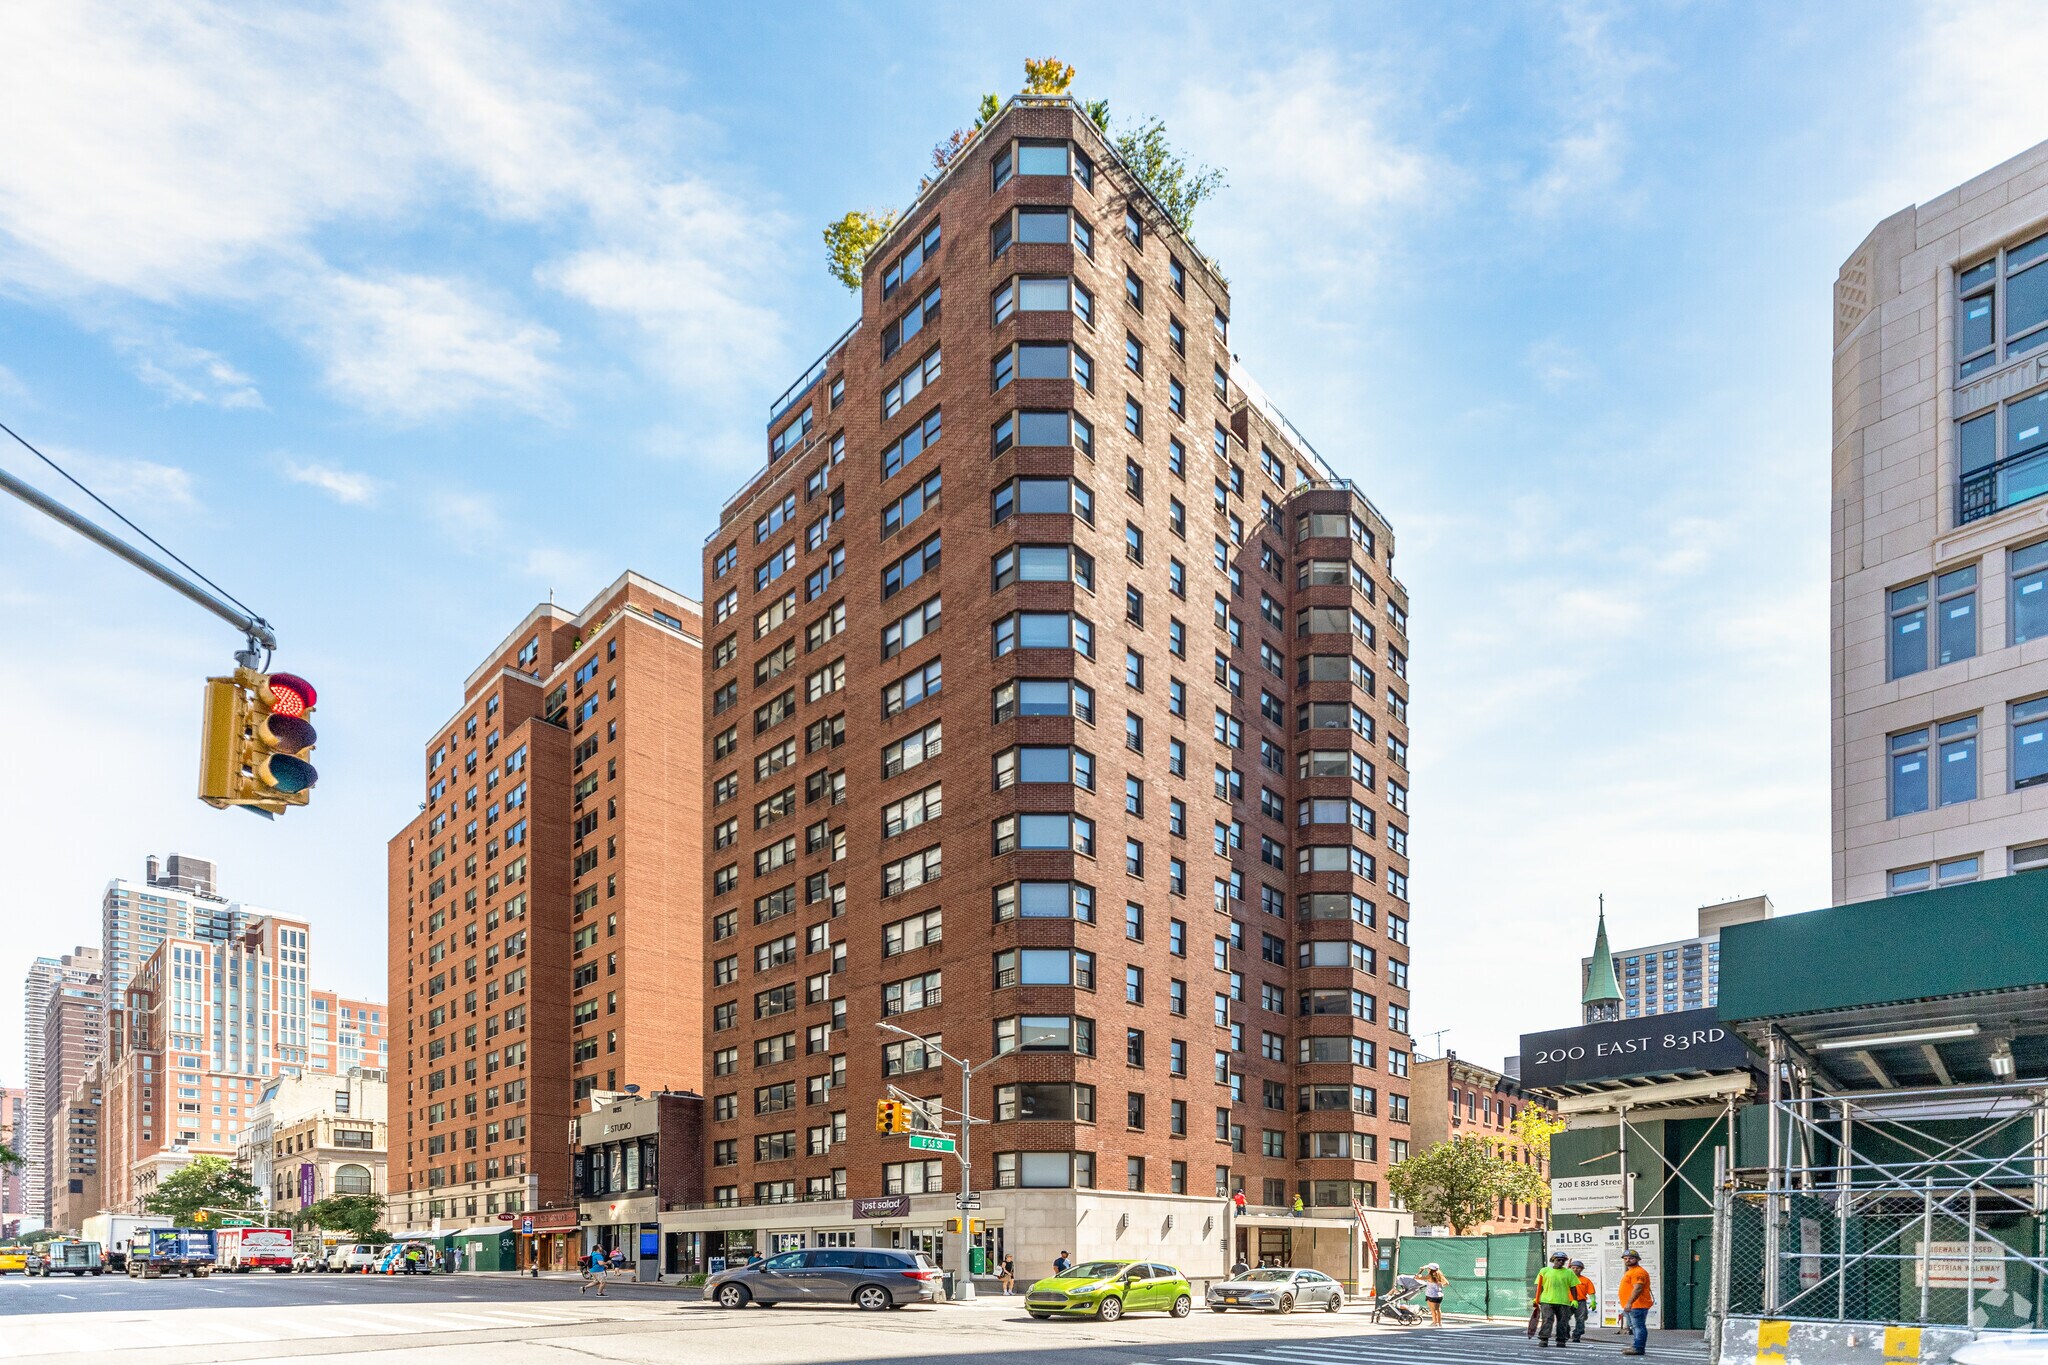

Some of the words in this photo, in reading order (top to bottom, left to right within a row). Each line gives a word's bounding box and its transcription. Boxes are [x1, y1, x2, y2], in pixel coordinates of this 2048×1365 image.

[1535, 1046, 1585, 1065] 200
[1597, 1037, 1652, 1057] EAST
[1663, 1028, 1725, 1050] 83RD
[610, 1122, 632, 1133] STUDIO
[922, 1139, 926, 1147] E
[936, 1140, 943, 1149] St
[1558, 1181, 1572, 1189] 200
[1580, 1179, 1599, 1188] 83rd
[1600, 1179, 1623, 1187] Stree
[877, 1199, 900, 1209] salad
[1566, 1232, 1592, 1244] LBG
[1624, 1228, 1650, 1240] BG
[1964, 1246, 1993, 1254] COSED
[1920, 1264, 1962, 1272] PDESTRIAN
[1964, 1264, 2000, 1272] WLKWAY
